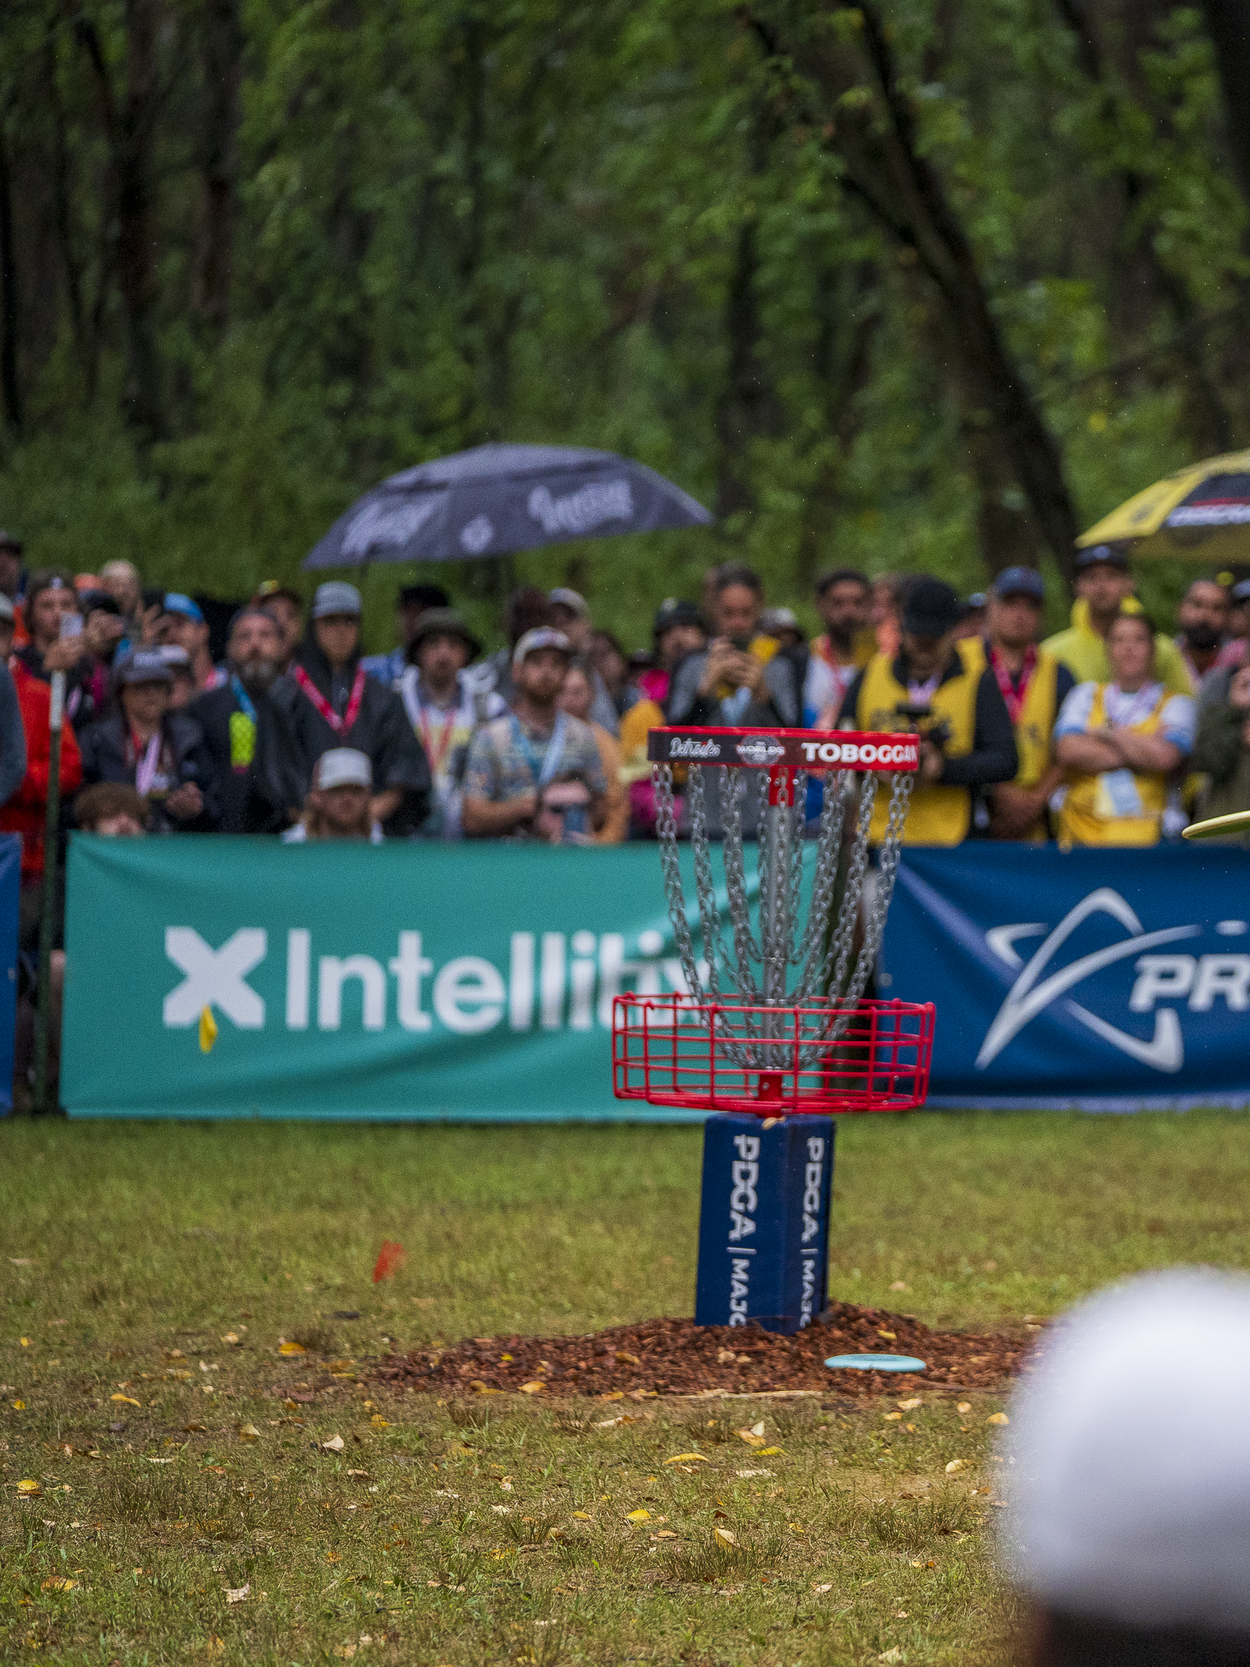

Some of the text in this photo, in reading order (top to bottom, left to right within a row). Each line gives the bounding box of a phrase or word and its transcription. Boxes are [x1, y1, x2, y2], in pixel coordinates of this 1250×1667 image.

[736, 745, 785, 756] WORLDS
[801, 742, 918, 764] TOBOGGAN
[728, 1134, 761, 1242] PDGA
[801, 1136, 825, 1243] PDGA
